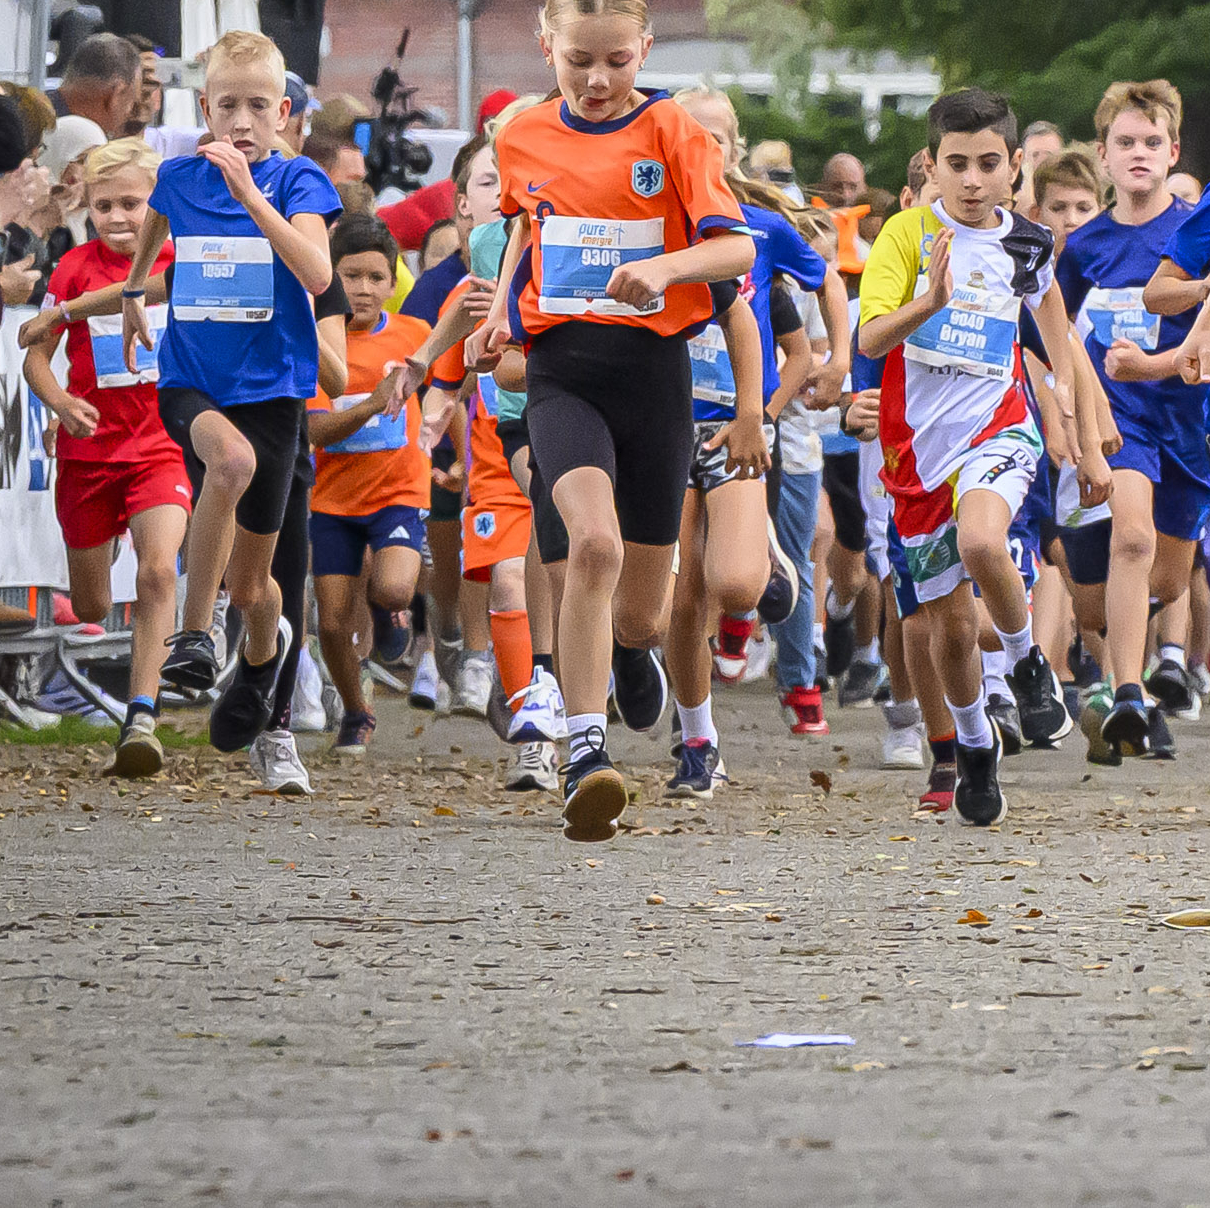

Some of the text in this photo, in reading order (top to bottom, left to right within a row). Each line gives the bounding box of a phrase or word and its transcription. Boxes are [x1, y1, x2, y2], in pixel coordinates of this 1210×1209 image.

[578, 222, 606, 237] pure
[581, 248, 621, 267] 9306
[202, 263, 236, 279] 10557
[949, 310, 986, 331] 9040
[939, 323, 988, 350] Bryan
